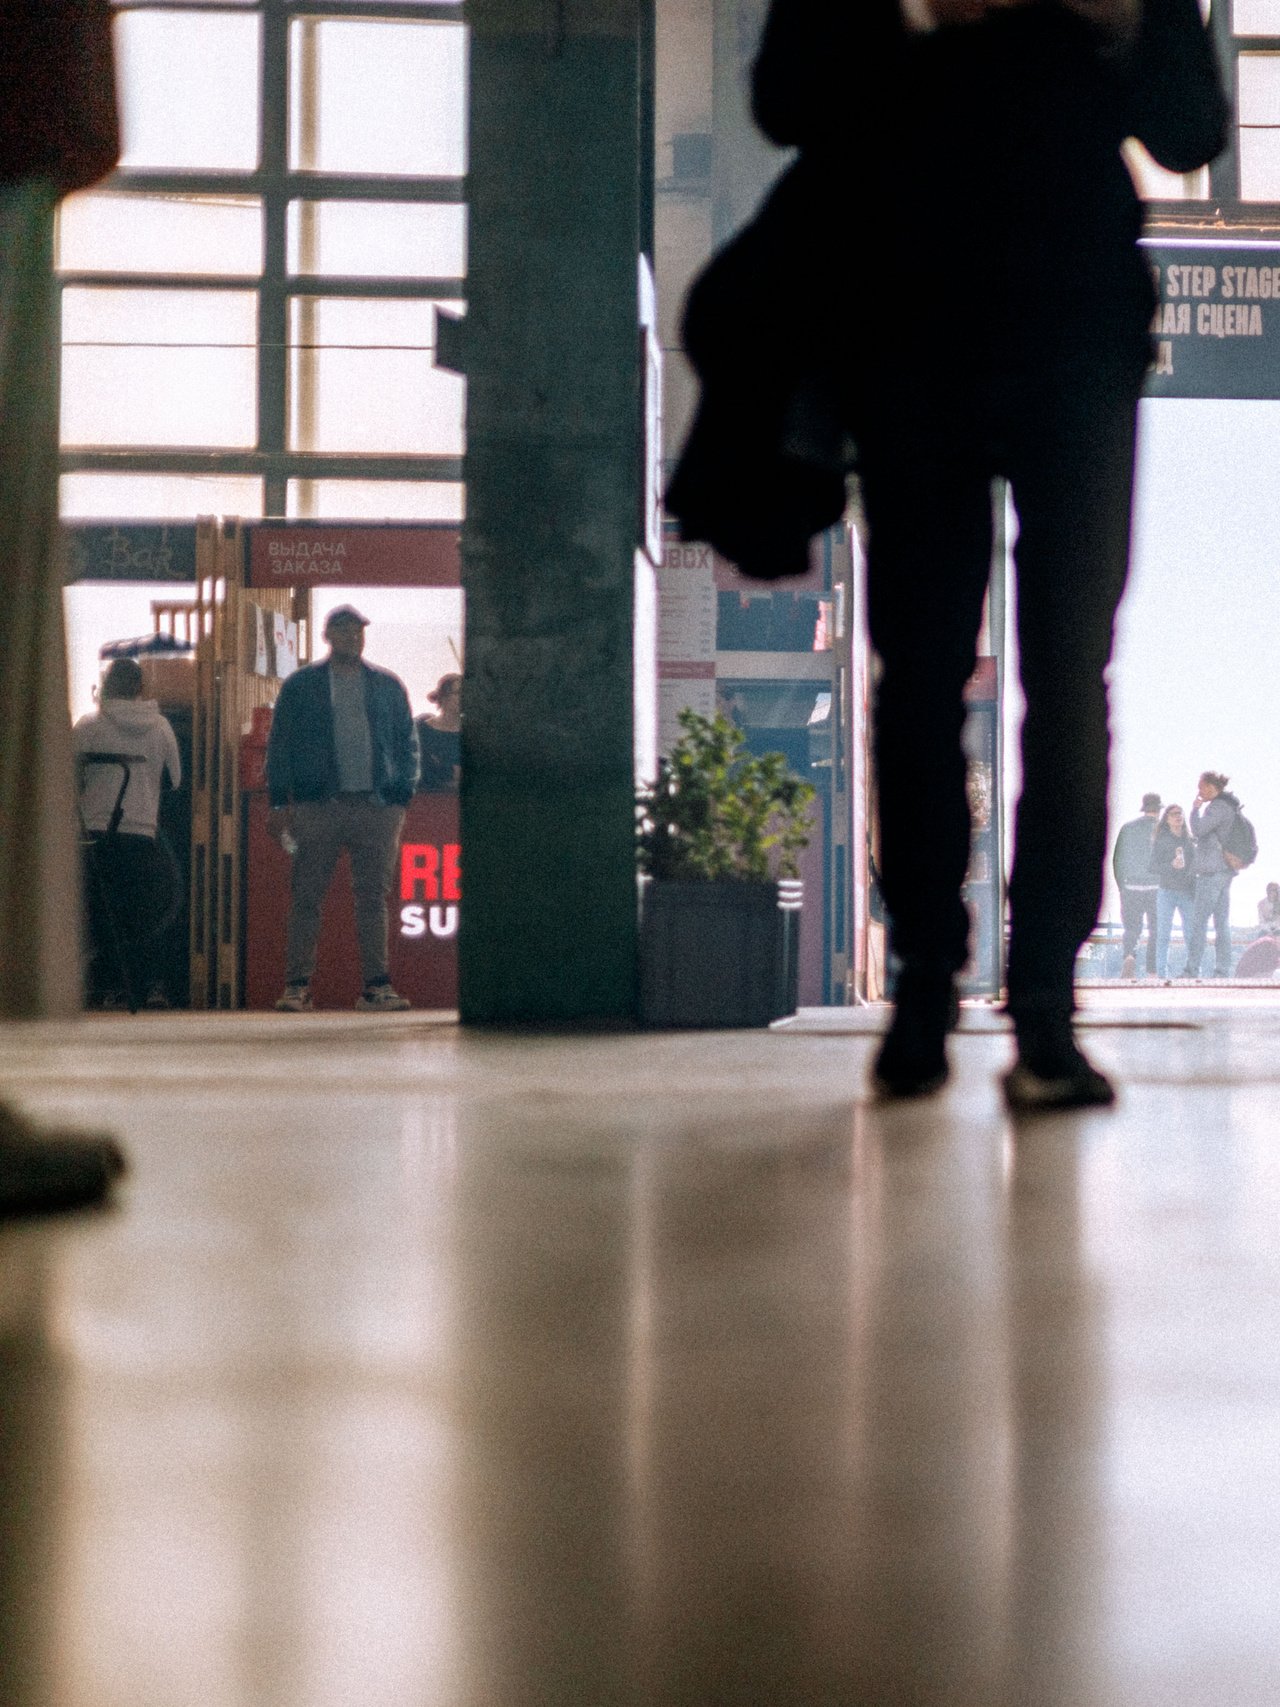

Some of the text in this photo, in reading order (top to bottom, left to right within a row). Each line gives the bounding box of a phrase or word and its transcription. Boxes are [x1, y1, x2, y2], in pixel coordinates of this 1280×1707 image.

[1166, 264, 1217, 298] STEP
[1197, 303, 1262, 338] СЦЕНА
[1152, 341, 1174, 376] Д
[268, 541, 347, 558] ВЫДАЧА
[272, 559, 343, 574] ЗАКАЗА
[400, 905, 459, 937] SU
